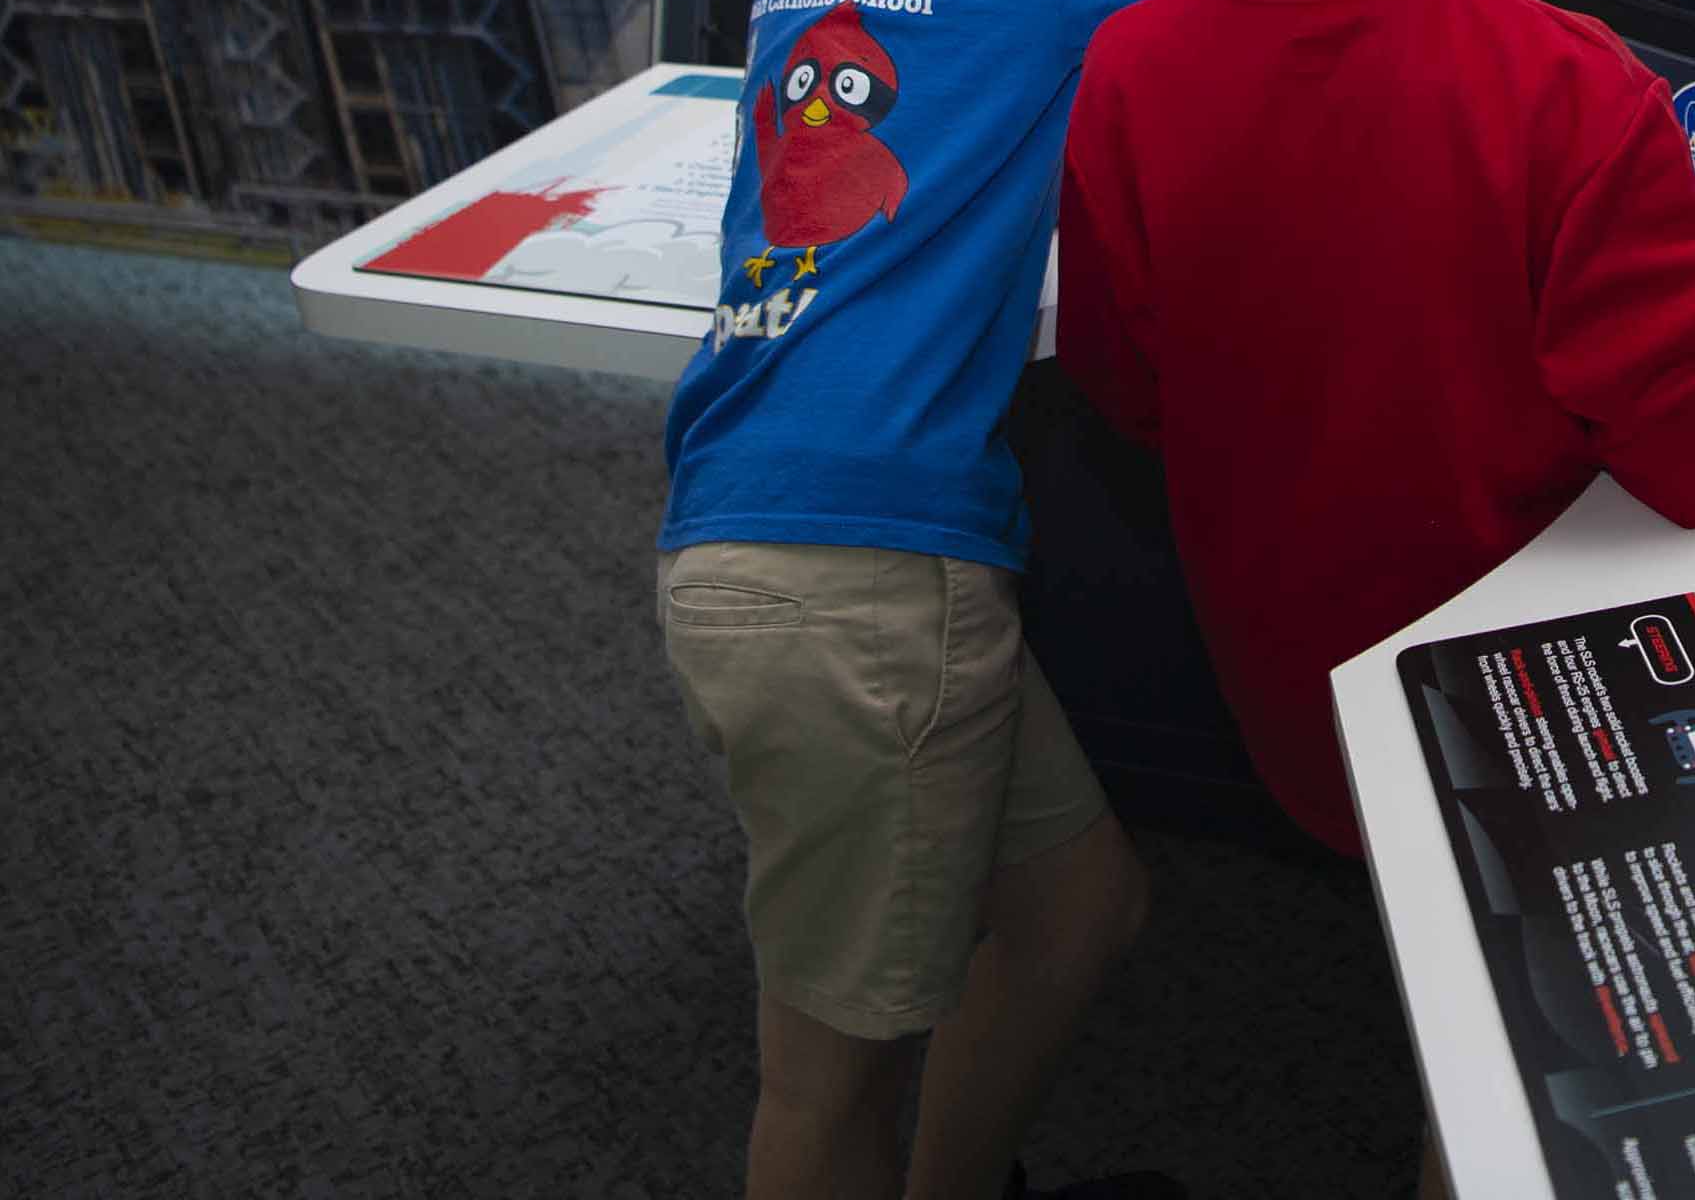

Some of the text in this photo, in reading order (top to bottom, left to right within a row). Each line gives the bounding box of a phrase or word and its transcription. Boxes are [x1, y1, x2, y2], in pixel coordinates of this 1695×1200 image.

[1540, 642, 1554, 655] the
[1557, 640, 1573, 654] and
[1645, 626, 1678, 673] STEERING
[1477, 656, 1493, 674] front
[1546, 654, 1562, 674] force
[1564, 654, 1578, 670] four
[1483, 674, 1502, 702] wheels
[1554, 674, 1568, 684] of
[1557, 684, 1576, 706] thrust
[1491, 702, 1512, 730] quickly
[1494, 652, 1552, 789] wheel racecar drivers to direct the
[1564, 706, 1586, 734] during
[1573, 636, 1650, 794] The SLS rocket's two solid rocket boosters
[1579, 696, 1602, 728] engines
[1504, 731, 1520, 748] and
[1534, 716, 1569, 783] steering enables
[1577, 732, 1598, 760] launch
[1588, 760, 1606, 777] and
[1608, 760, 1620, 771] to
[1612, 770, 1632, 797] direct
